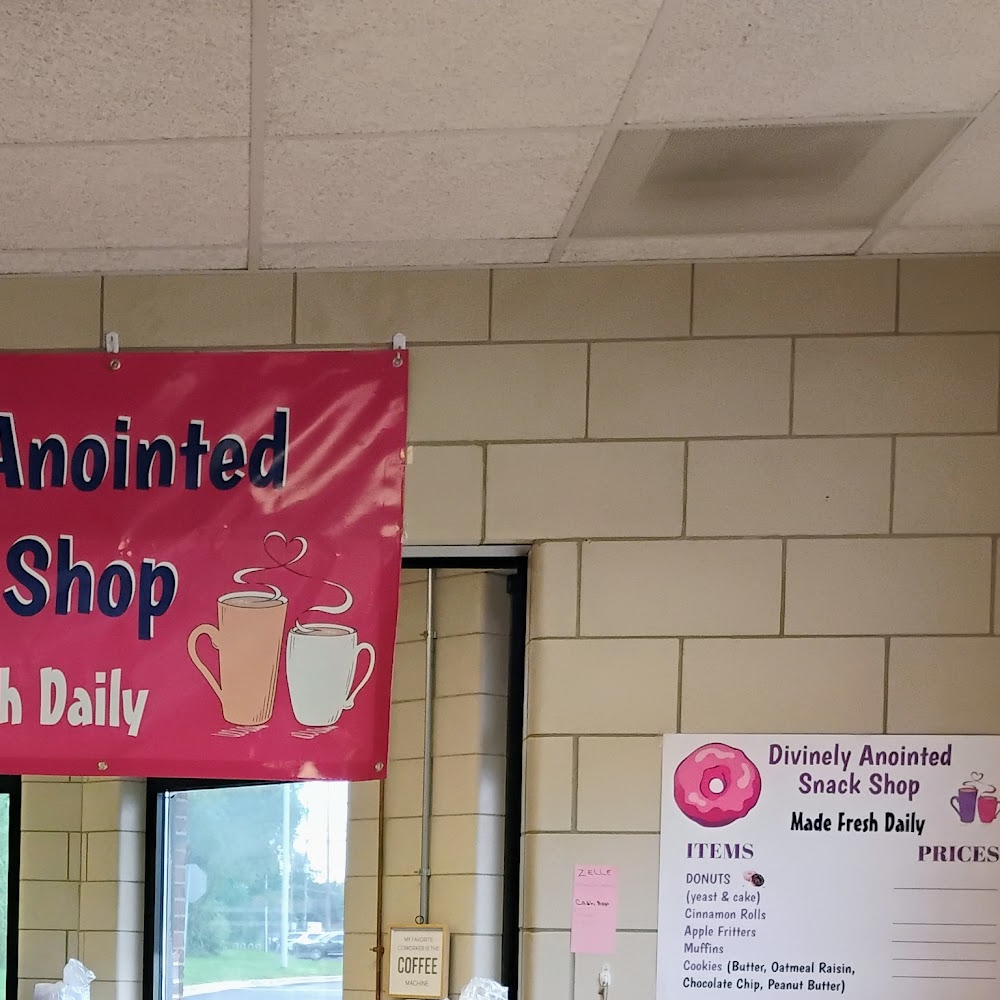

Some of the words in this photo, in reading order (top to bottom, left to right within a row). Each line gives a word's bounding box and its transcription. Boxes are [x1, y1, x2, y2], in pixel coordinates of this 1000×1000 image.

[3, 535, 180, 640] Shop
[40, 668, 150, 737] Daily
[769, 744, 851, 771] Divinely
[859, 744, 952, 766] Anointed
[799, 772, 860, 794] Snack
[869, 773, 919, 801] Shop
[791, 812, 831, 831] Made
[838, 812, 878, 832] Fresh
[885, 812, 925, 835] Daily
[688, 843, 753, 859] ITEMS
[919, 846, 999, 862] PRICES
[578, 869, 611, 877] ZELLE
[687, 873, 730, 884] DONUTS
[687, 890, 717, 904] (yeast
[721, 891, 729, 901] &
[733, 891, 760, 905] cake)
[685, 908, 735, 919] Cinnamon
[741, 909, 766, 919] Rolls
[684, 925, 713, 939] Apple
[718, 926, 756, 937] Fritters
[684, 943, 723, 953] Muffins
[398, 956, 438, 974] COFFEE
[684, 960, 722, 971] Cookies
[728, 961, 766, 974] (Butter,
[772, 962, 814, 972] Oatmeal
[819, 962, 854, 975] Raisin,
[683, 977, 732, 988] Chocolate
[737, 978, 762, 992] Chip,
[769, 979, 803, 989] Peanut
[808, 980, 845, 994] Butter)
